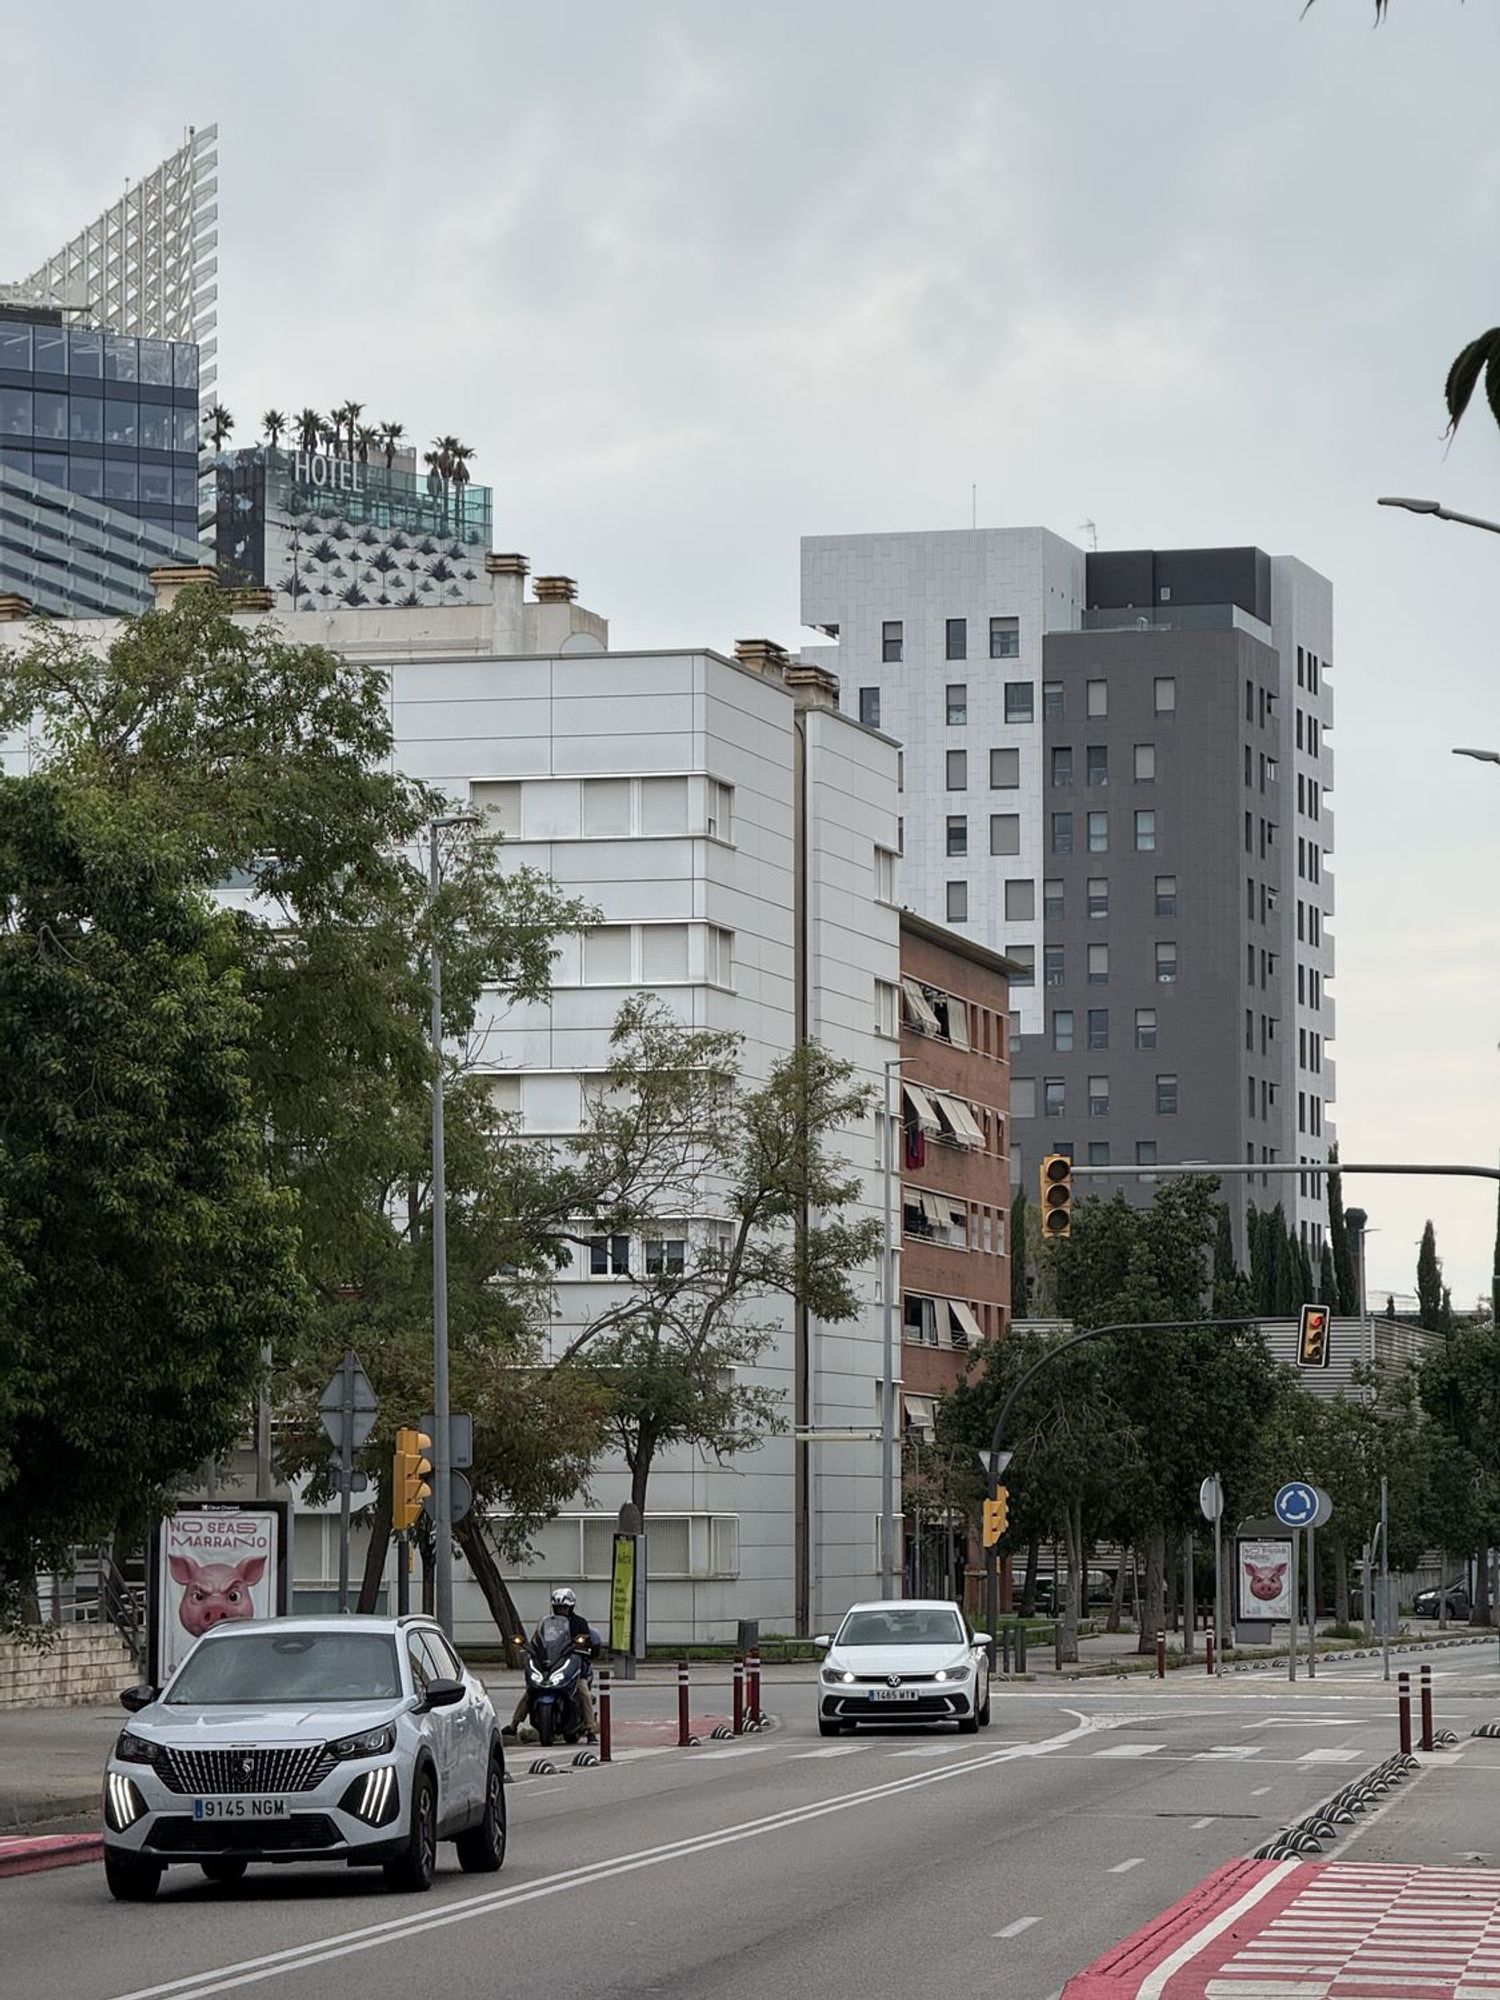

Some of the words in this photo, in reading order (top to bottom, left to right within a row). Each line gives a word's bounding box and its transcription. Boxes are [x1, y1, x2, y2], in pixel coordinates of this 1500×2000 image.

[295, 451, 364, 493] HOTEL
[171, 1521, 203, 1533] NO
[207, 1522, 257, 1534] SEAS
[171, 1536, 267, 1548] MARRANO
[205, 1801, 245, 1816] 9145
[252, 1799, 284, 1815] NGM
